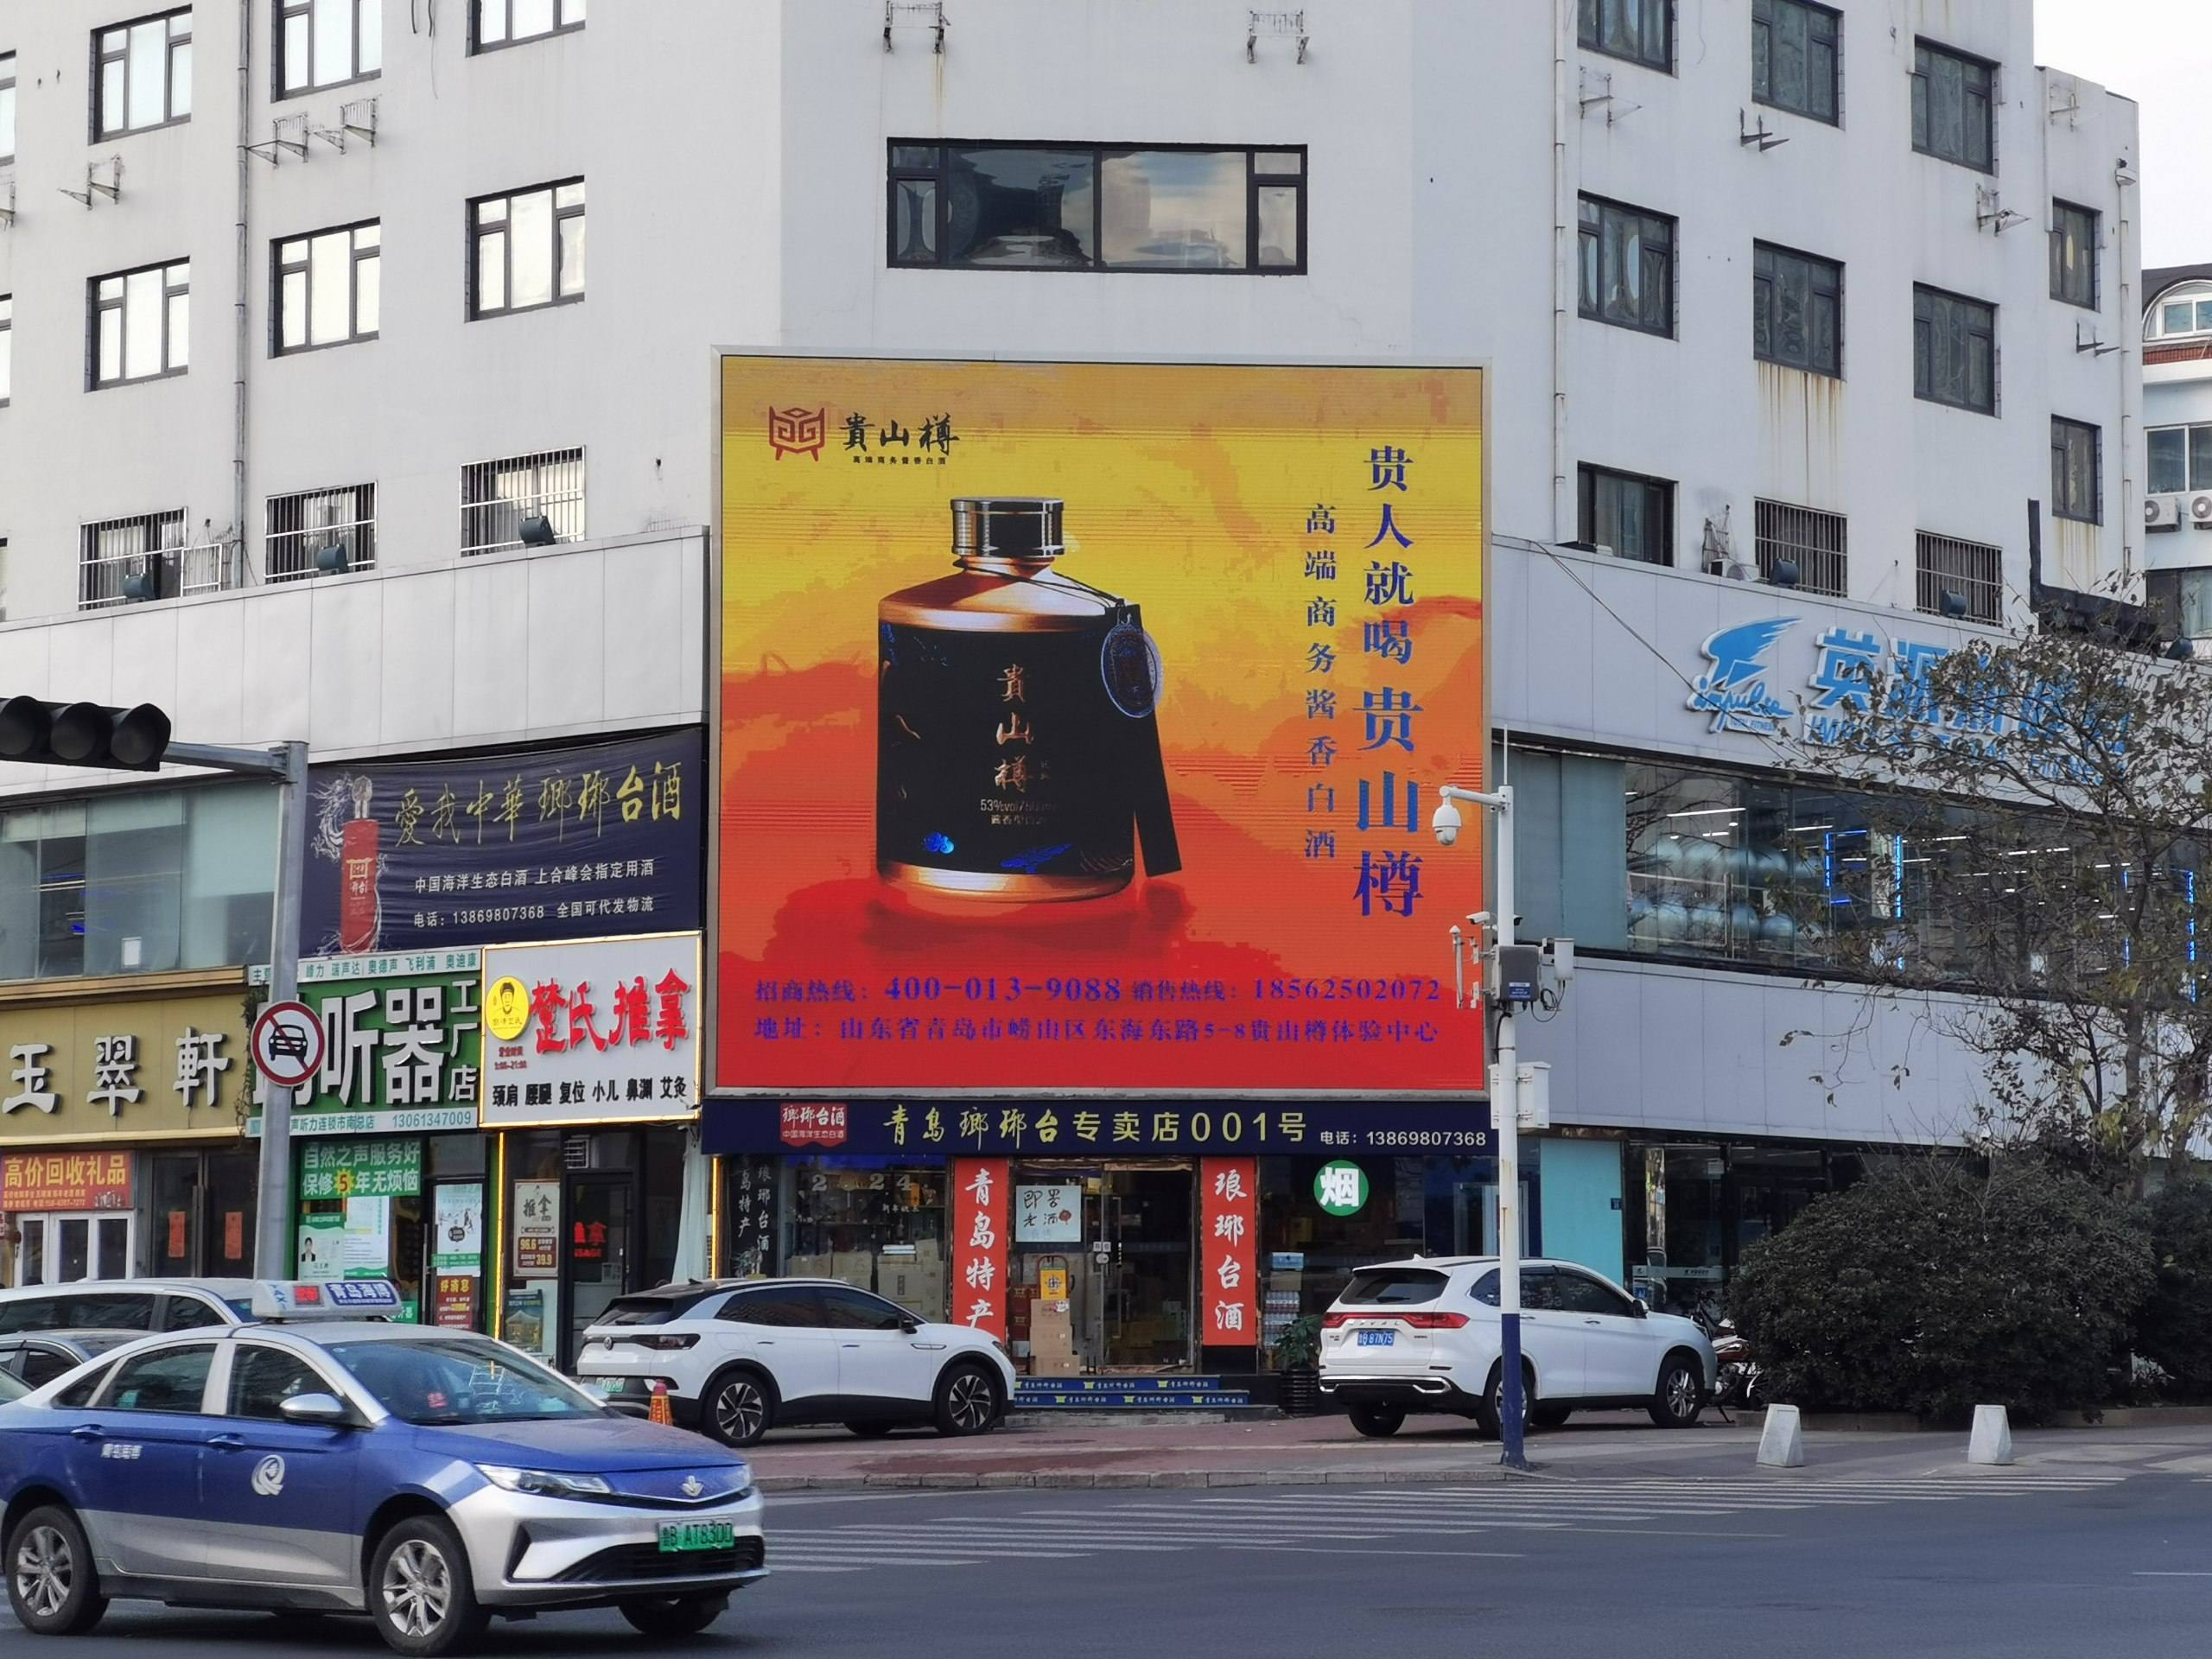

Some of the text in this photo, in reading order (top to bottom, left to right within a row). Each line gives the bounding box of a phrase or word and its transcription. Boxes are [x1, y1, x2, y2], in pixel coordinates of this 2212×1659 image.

[1304, 503, 1338, 858] 高端商务酱香白酒
[1352, 445, 1424, 918] 贵人就喝贵山樽
[415, 859, 654, 893] 中国海洋生态白酒 上合峰会指定用酒
[556, 896, 654, 919] 全国可代发物流
[305, 963, 325, 978] 峰力
[367, 957, 398, 975] 奥德声
[405, 955, 436, 971] 飞利浦
[445, 952, 477, 969] 奥迪康
[448, 979, 479, 1101] 工厂店
[493, 1084, 518, 1108] 颈肩
[524, 1083, 552, 1107] 腰腿
[558, 1080, 586, 1105] 复位
[592, 1078, 620, 1103] 小儿
[659, 1075, 688, 1100] 艾灸
[392, 1111, 472, 1128] 13061347009
[4, 1154, 125, 1188] 高价回收礼品
[303, 1142, 420, 1168] 自然之声服务好
[302, 1168, 419, 1197] 保修5年无烦恼
[1319, 1166, 1360, 1208] 烟
[522, 1193, 552, 1218] 推拿
[964, 1167, 997, 1331] 青岛特产
[440, 1279, 470, 1293] 好消息
